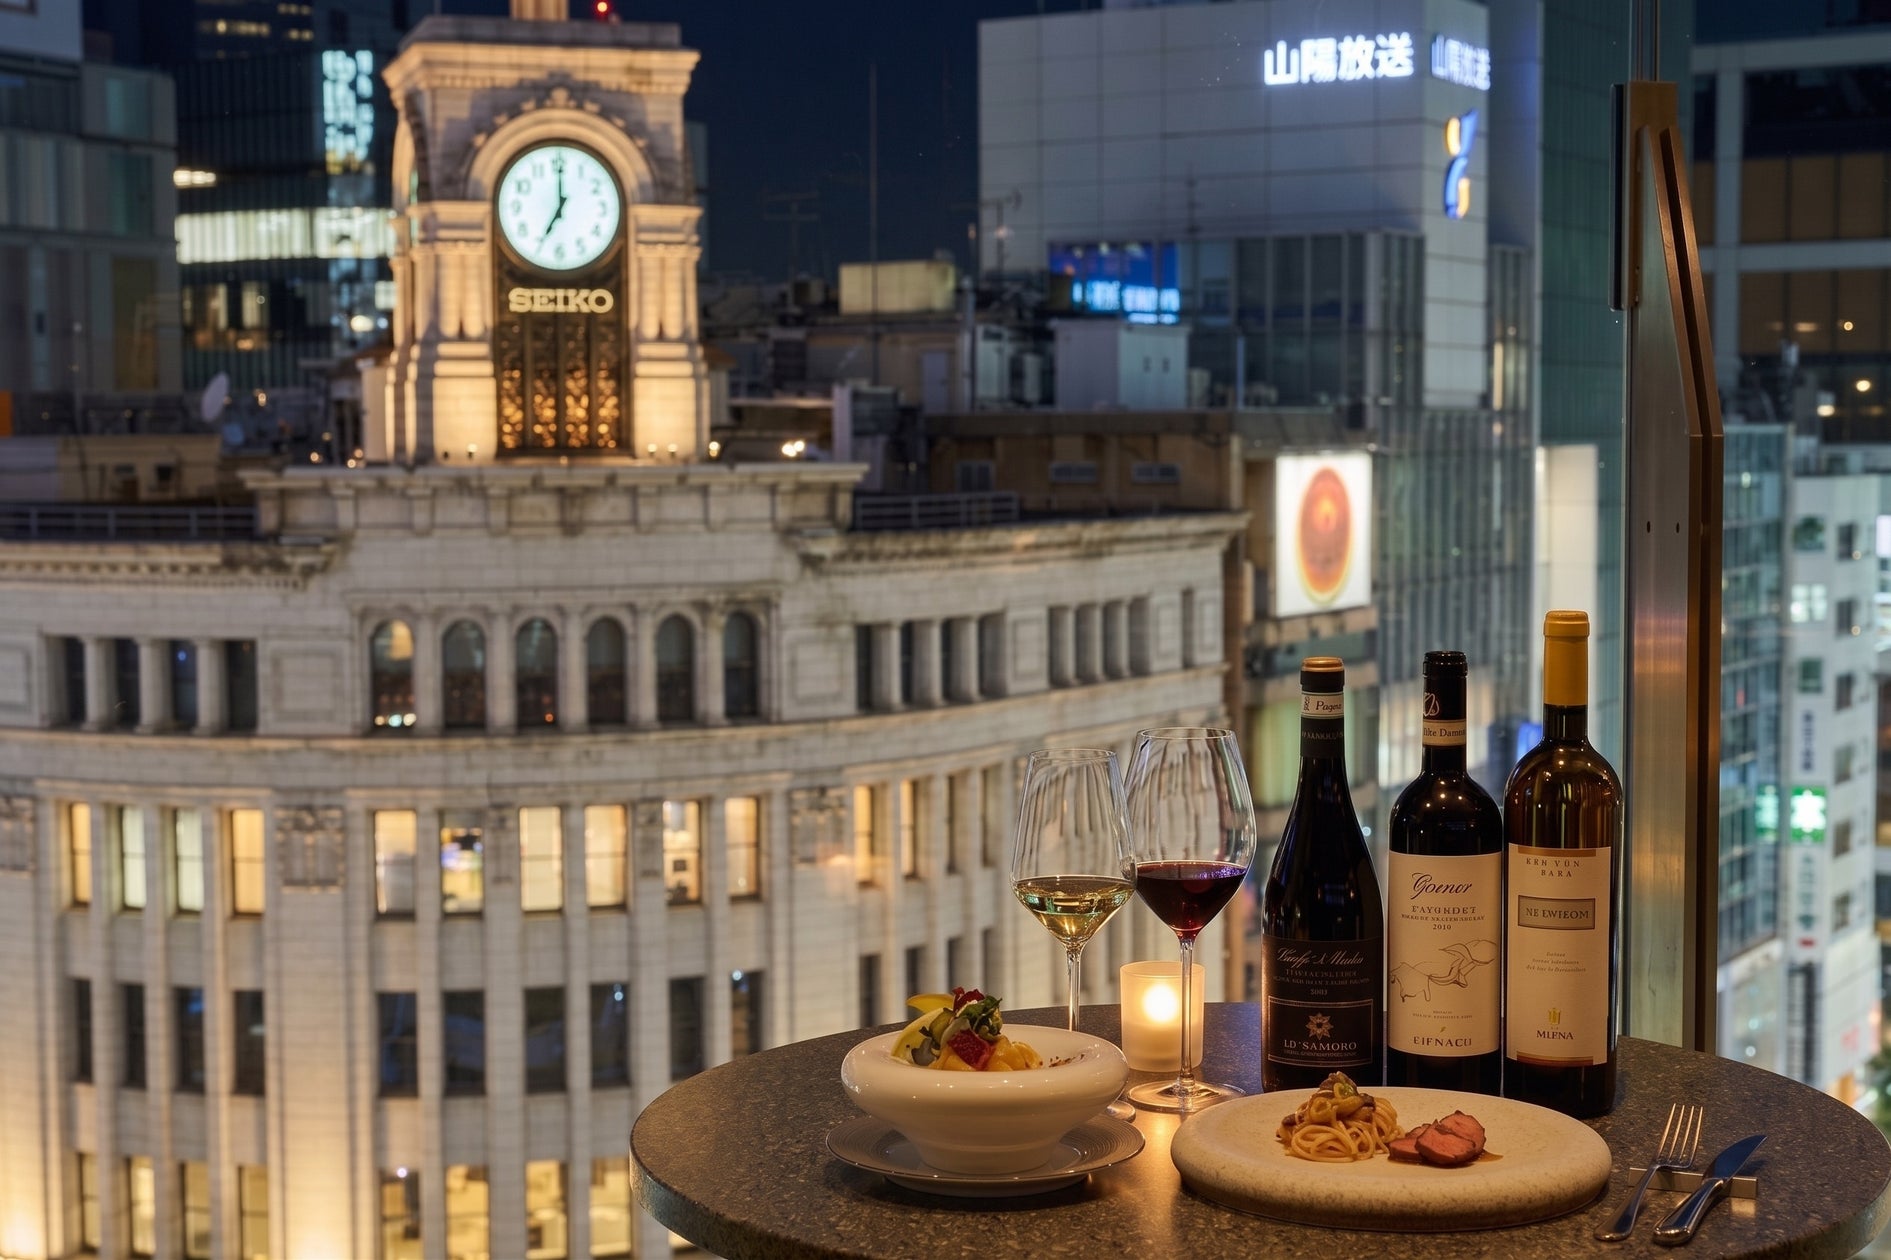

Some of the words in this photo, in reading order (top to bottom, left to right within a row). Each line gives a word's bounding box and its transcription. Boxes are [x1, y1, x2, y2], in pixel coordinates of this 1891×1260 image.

[1263, 31, 1414, 85] 山陽放送
[508, 287, 614, 313] SEIKO
[1432, 923, 1452, 931] 2010
